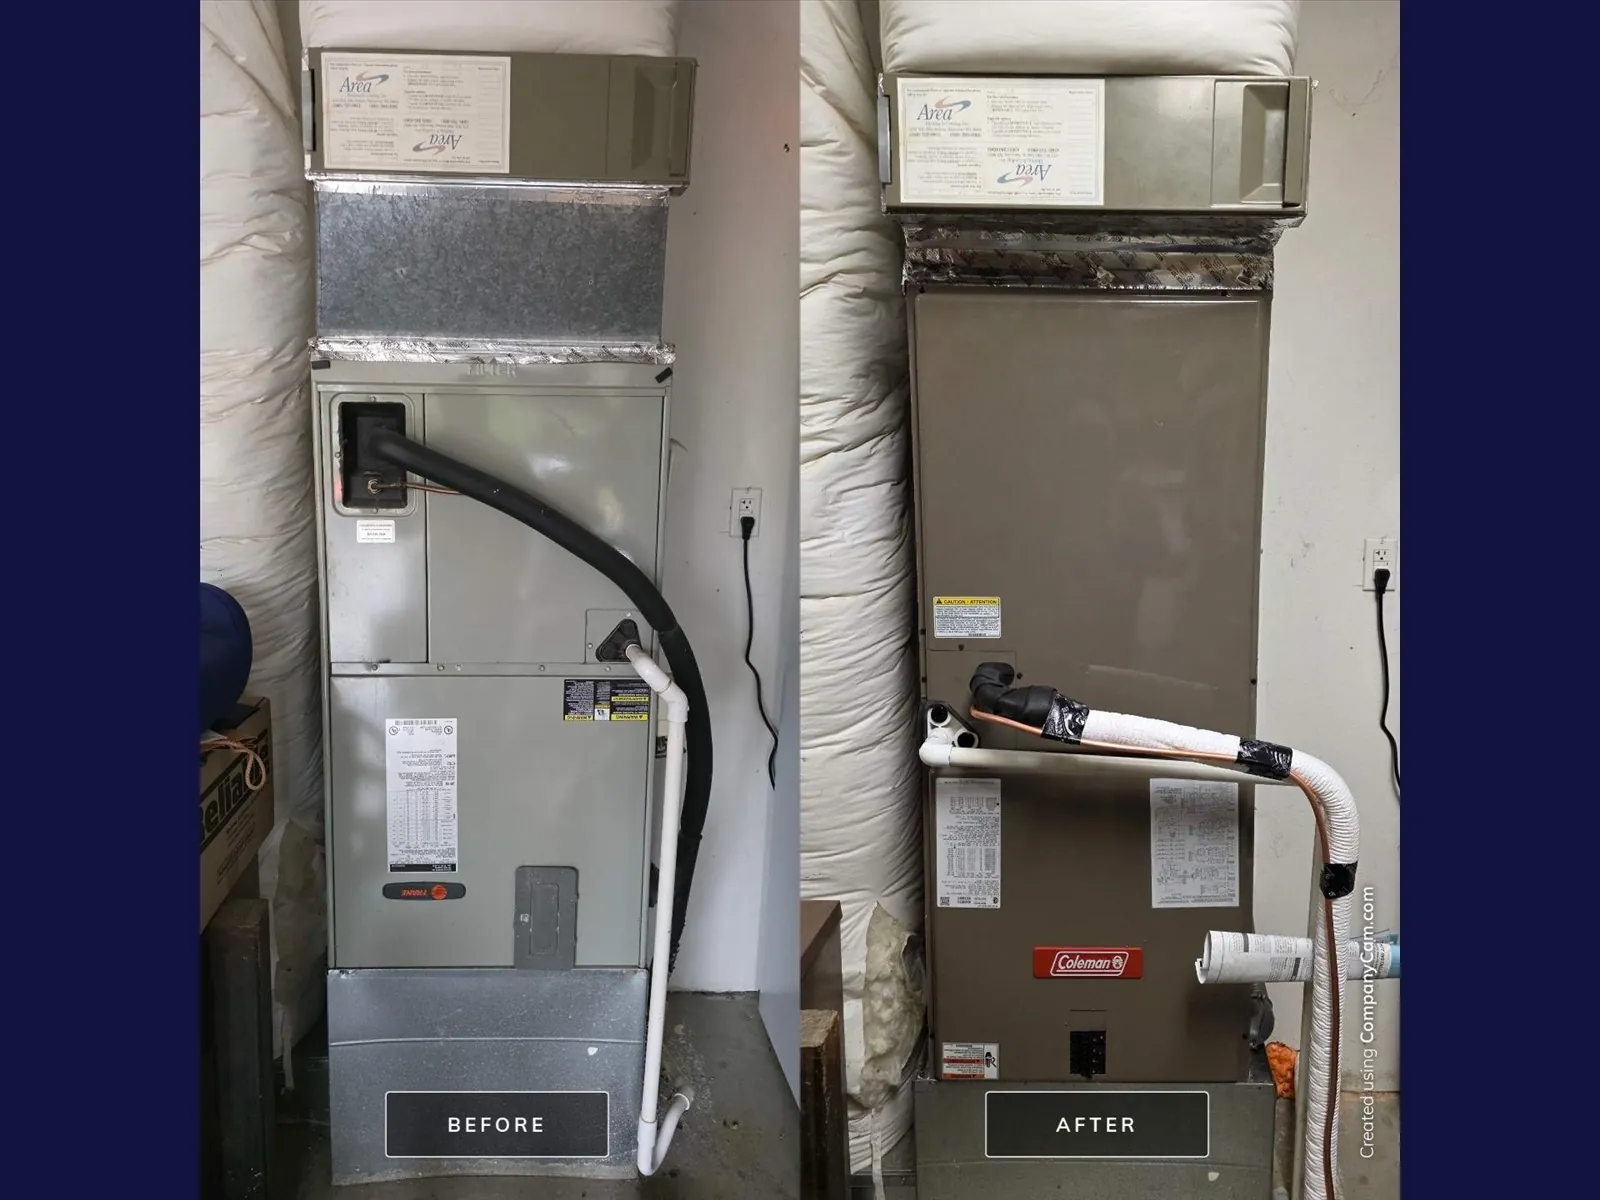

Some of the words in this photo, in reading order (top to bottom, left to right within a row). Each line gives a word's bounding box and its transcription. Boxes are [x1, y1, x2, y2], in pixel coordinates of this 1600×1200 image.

[340, 77, 373, 93] Area
[916, 104, 953, 121] Area
[429, 133, 462, 151] Area
[1016, 164, 1052, 182] Area
[400, 888, 428, 897] TRANE
[1057, 954, 1111, 970] Coleman
